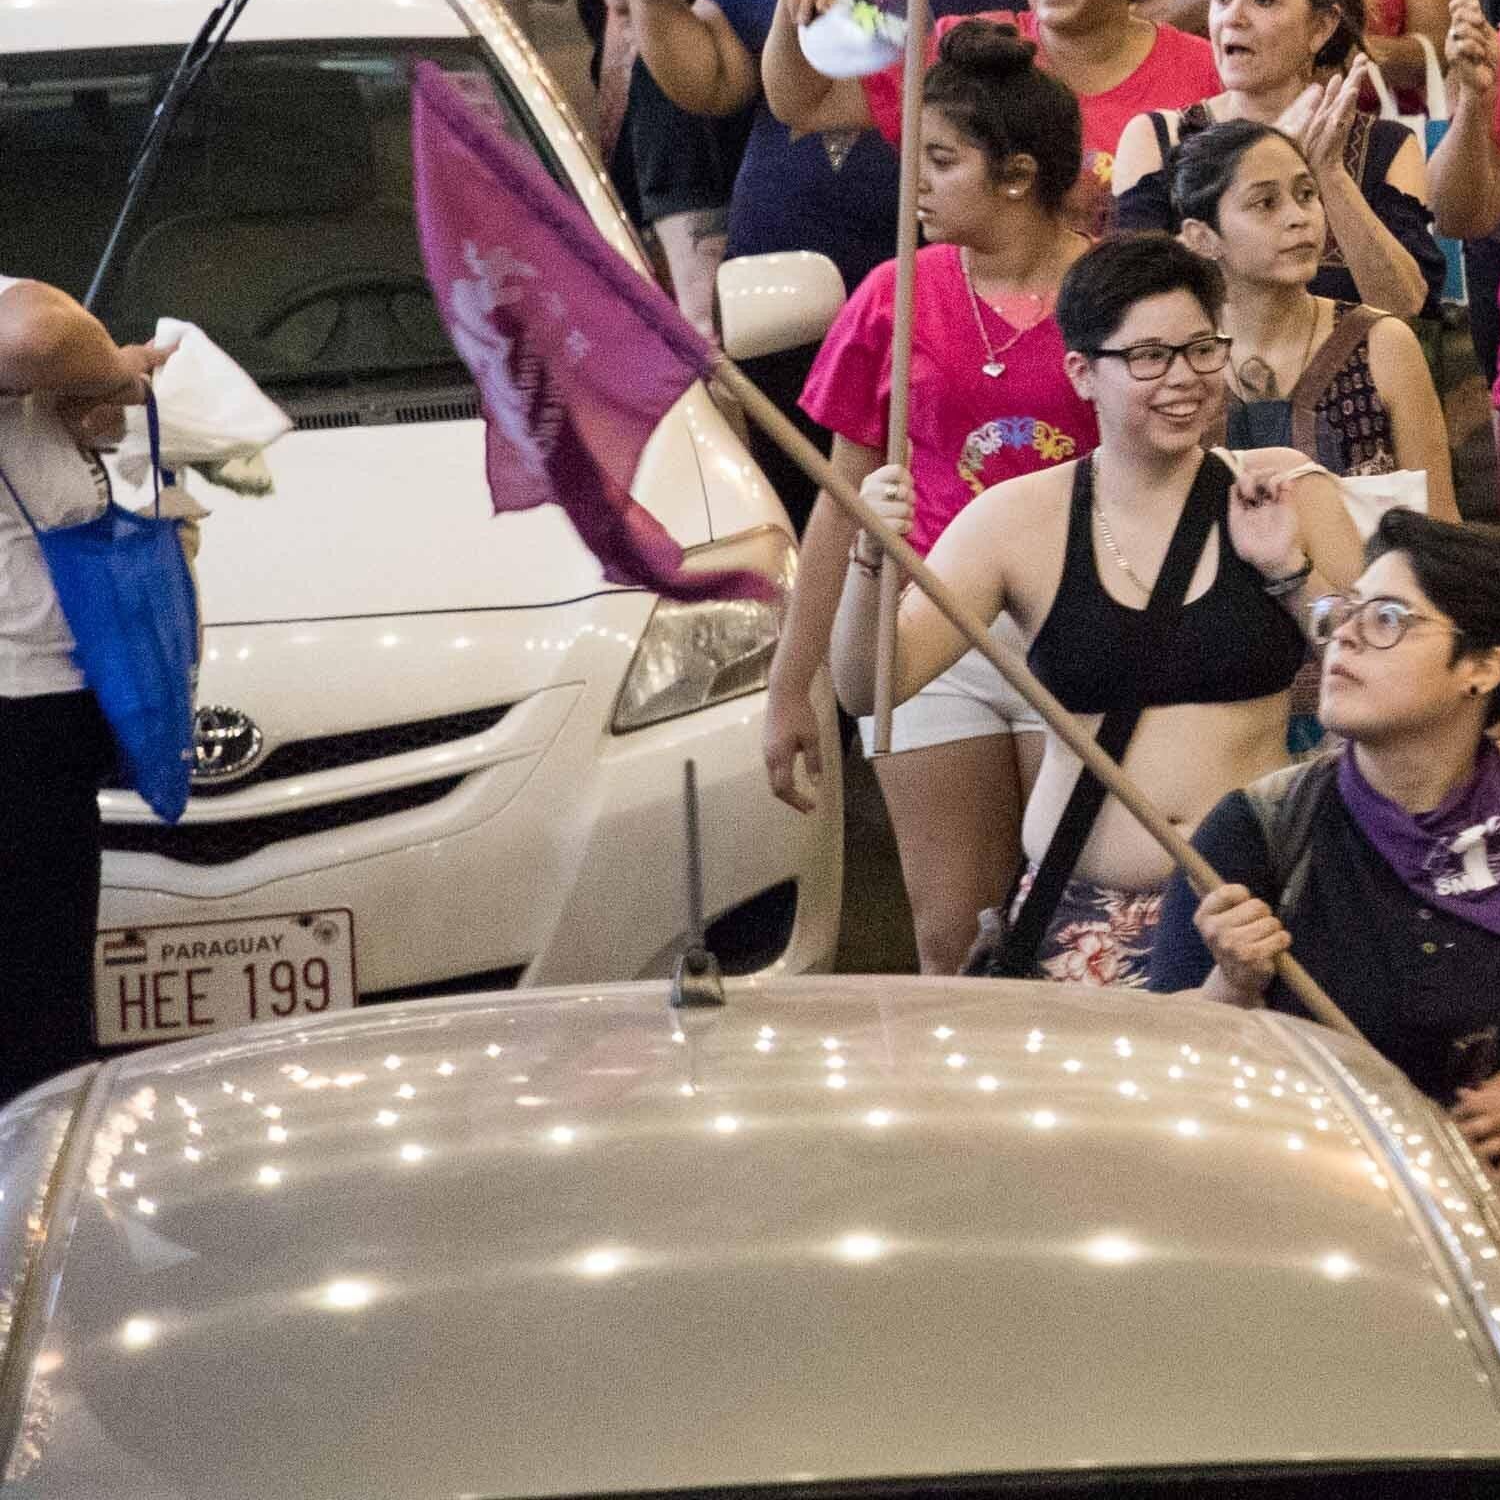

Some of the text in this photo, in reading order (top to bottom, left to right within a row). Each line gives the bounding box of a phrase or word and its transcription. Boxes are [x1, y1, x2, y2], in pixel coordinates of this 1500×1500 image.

[161, 932, 285, 961] PARAGUAY
[118, 956, 331, 1033] HEE 199
